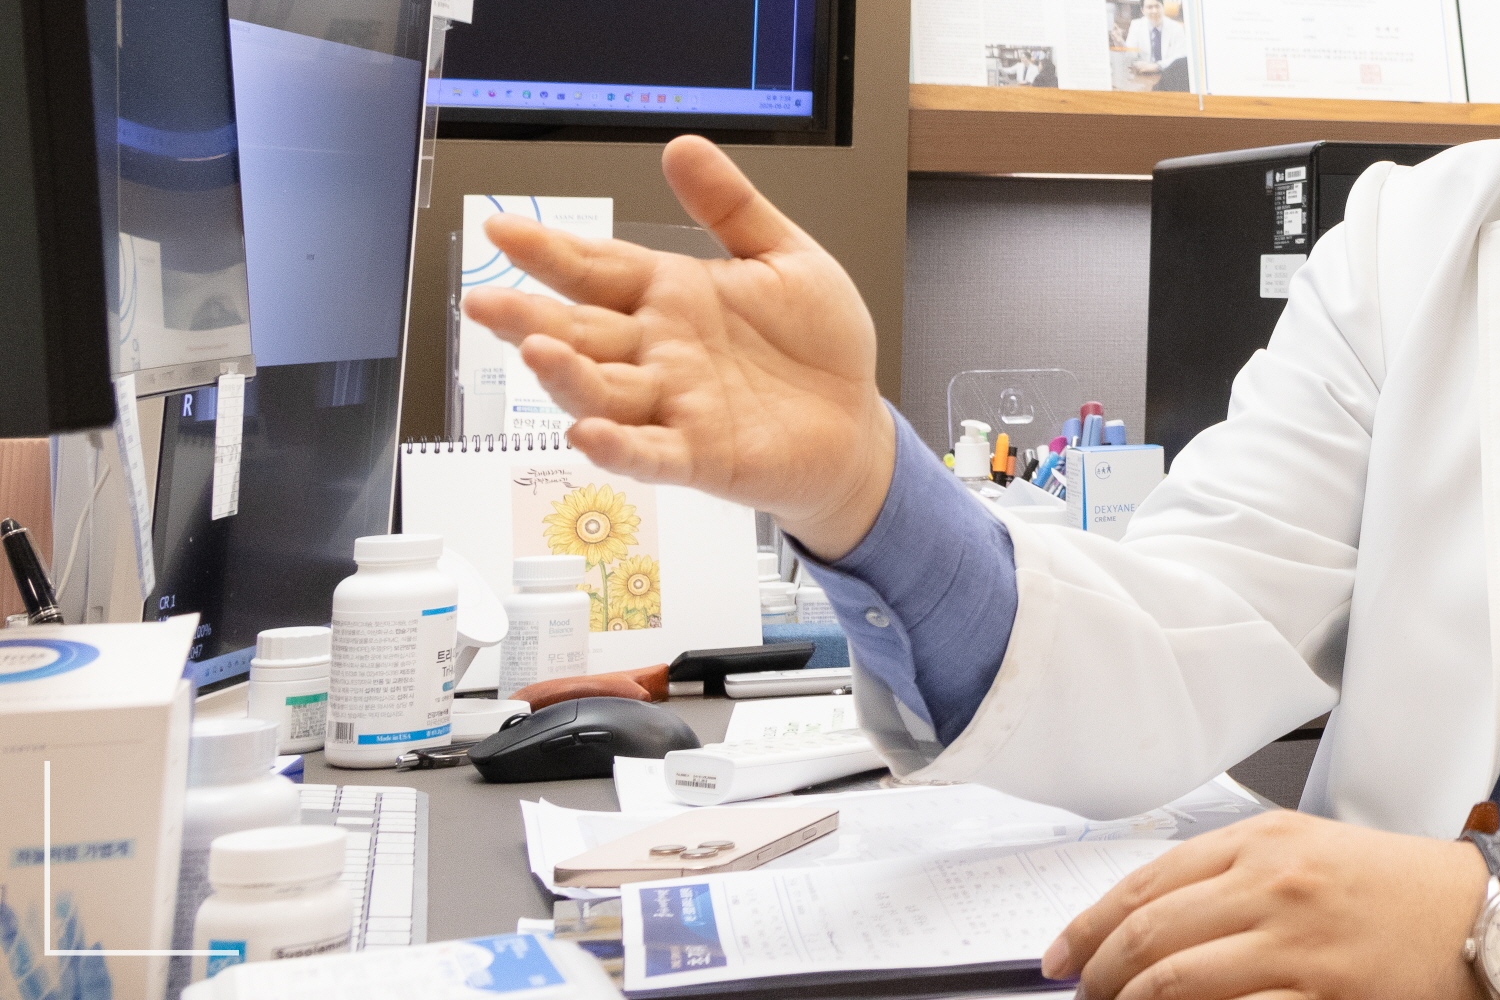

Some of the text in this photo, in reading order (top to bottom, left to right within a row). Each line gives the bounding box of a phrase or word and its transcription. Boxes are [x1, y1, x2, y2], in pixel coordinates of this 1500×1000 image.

[183, 394, 193, 417] R
[512, 418, 562, 430] 한약 치료
[1094, 503, 1136, 514] DEXYANE
[159, 596, 170, 610] CR
[549, 619, 570, 627] Mood
[548, 627, 574, 635] Balance
[548, 653, 565, 664] 무드
